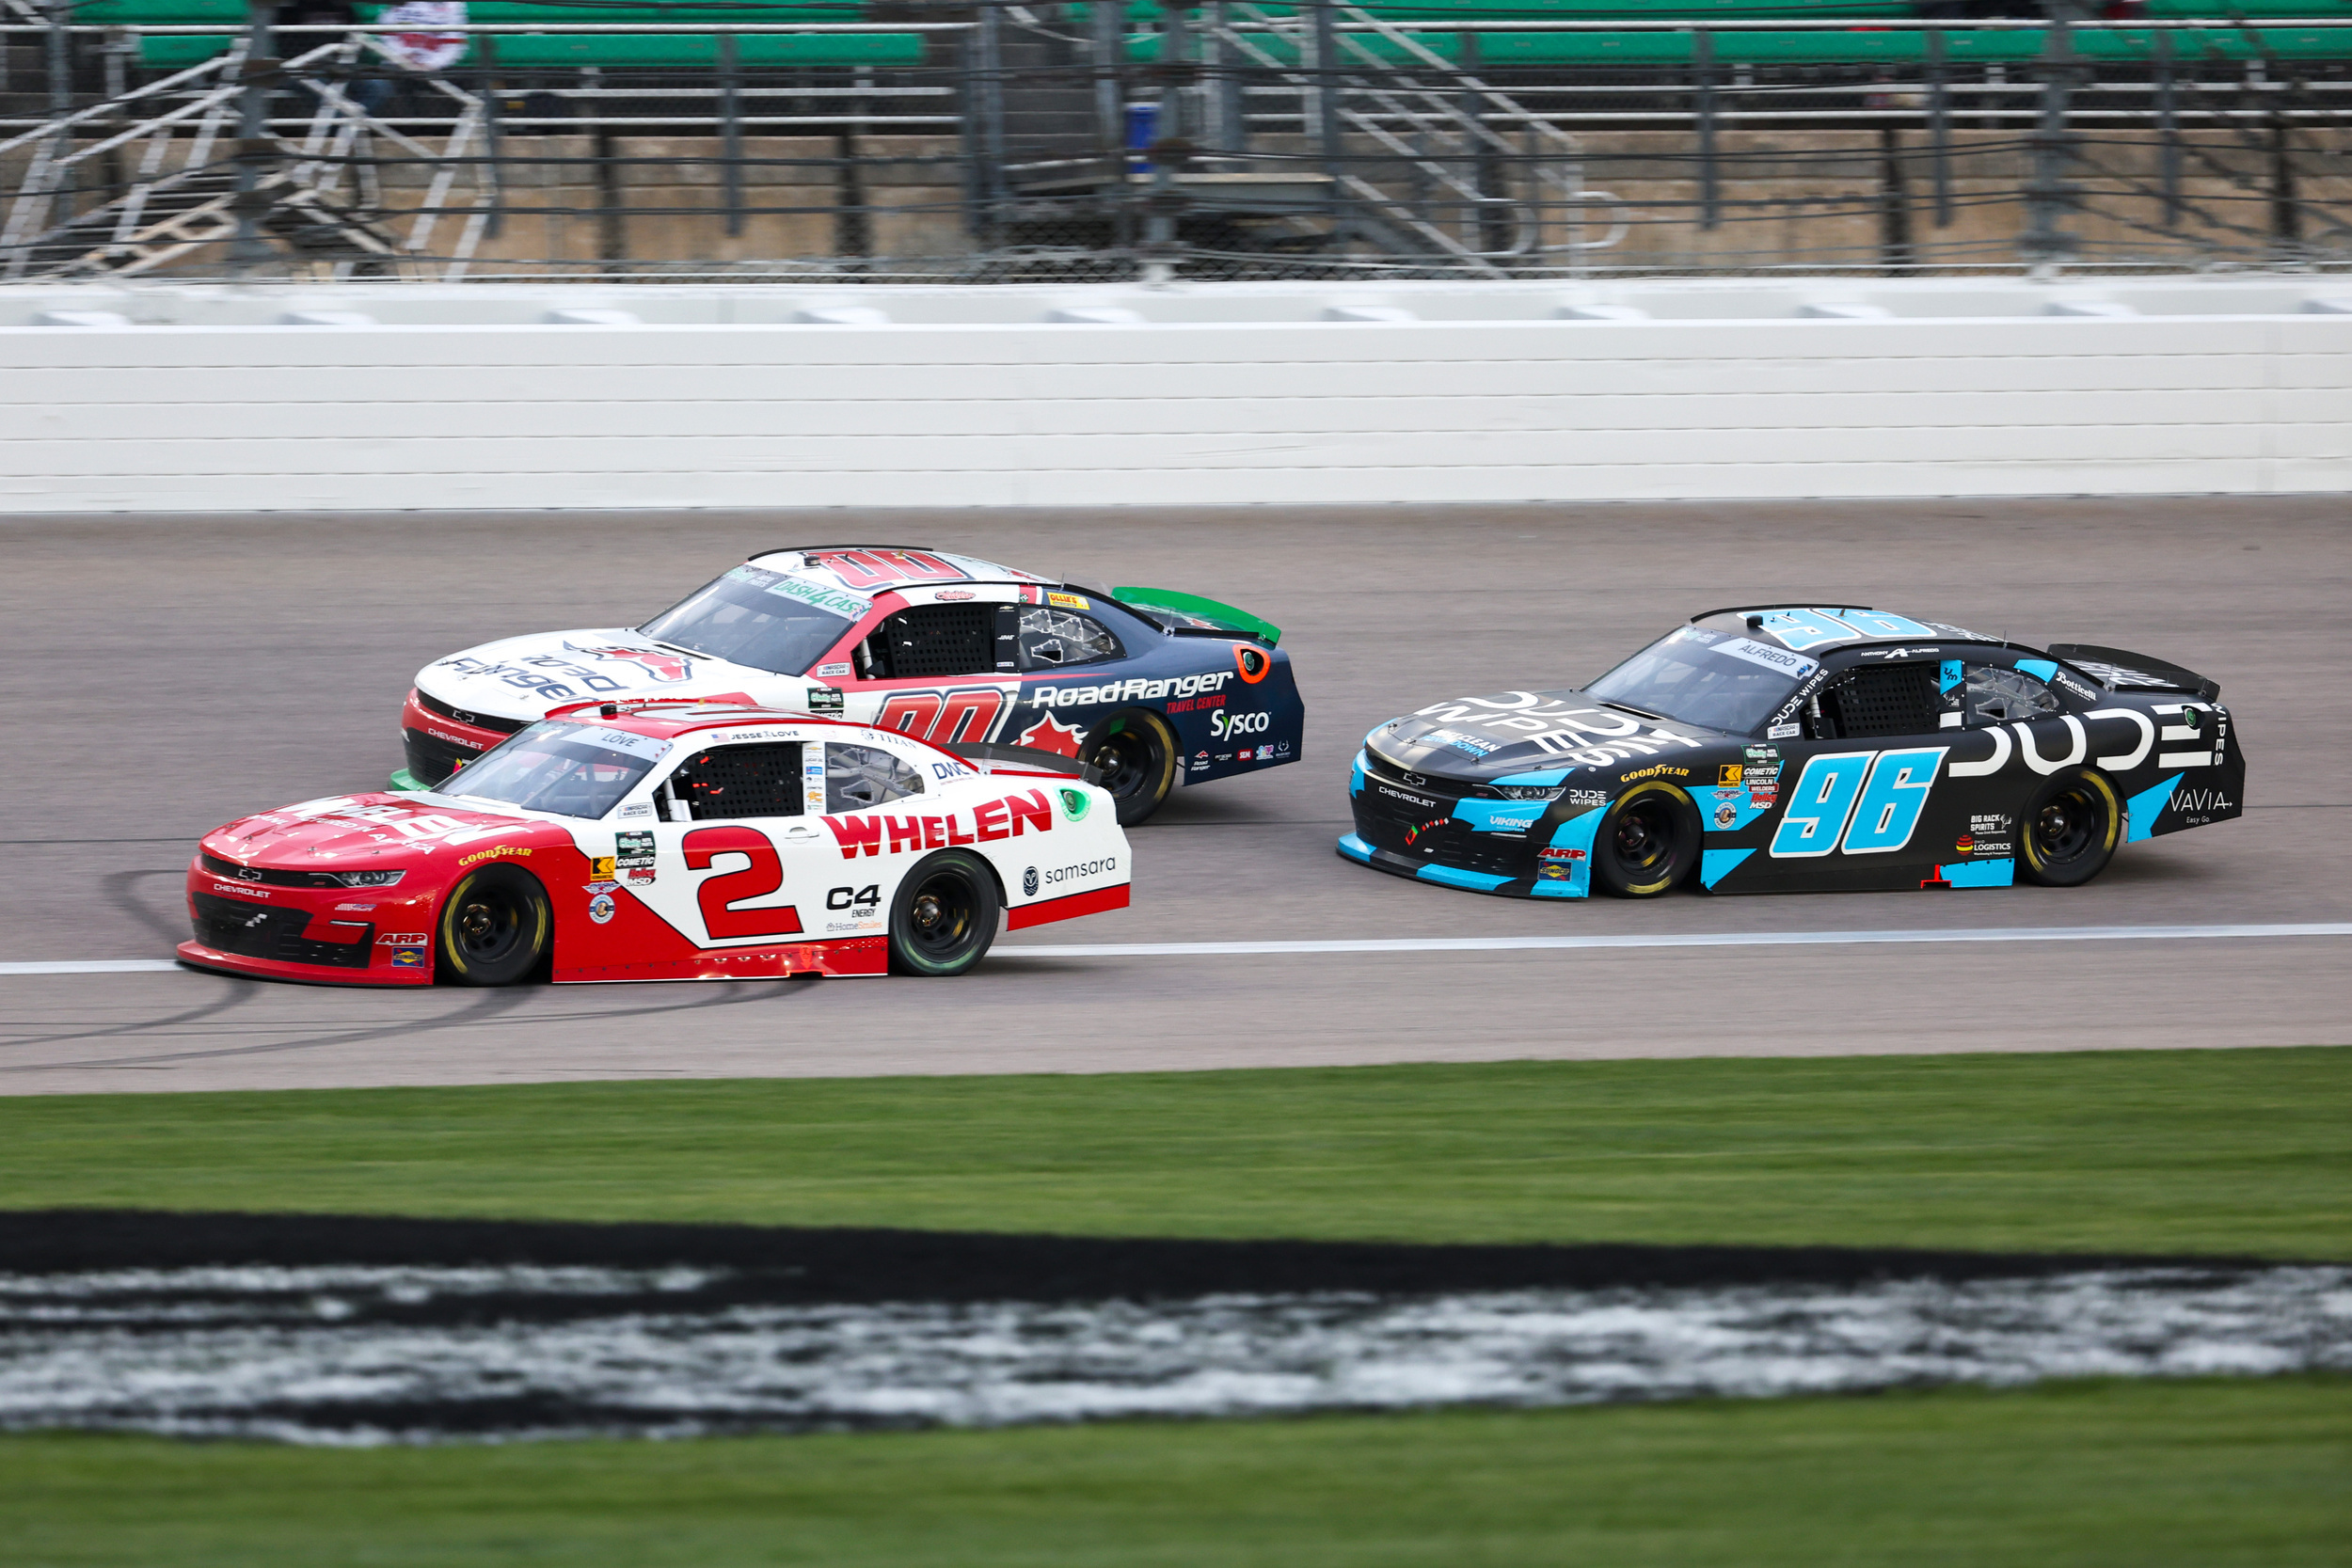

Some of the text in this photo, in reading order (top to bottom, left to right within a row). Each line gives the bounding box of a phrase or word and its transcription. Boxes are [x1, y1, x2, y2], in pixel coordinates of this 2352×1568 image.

[774, 580, 814, 597] DASH
[806, 590, 836, 606] 4
[1739, 644, 1797, 667] ALFREDO
[1799, 668, 1829, 697] WIPES
[2056, 671, 2097, 701] Botticelli
[1167, 694, 1227, 714] TRAVEL CENTER
[428, 728, 485, 750] CHEVROLET
[601, 734, 639, 747] LOVE
[731, 731, 763, 739] JESSE
[2211, 702, 2227, 767] WIPES
[877, 734, 917, 750] TITAN
[1450, 740, 1489, 757] DOWN
[1457, 735, 1502, 752] CLEAN
[1743, 766, 1778, 776] COMETIC
[1378, 786, 1437, 808] CHEVROLET
[1569, 789, 1607, 799] DUDE
[1751, 793, 1777, 803] Holley
[1570, 799, 1607, 807] WIPES
[1769, 746, 1950, 858] 96
[818, 788, 1052, 860] WHELEN
[1489, 815, 1534, 829] VIKING
[1971, 814, 2000, 823] BIG RACK
[2186, 816, 2200, 825] Easy
[1970, 823, 1994, 832] SPIRITS
[1540, 847, 1586, 860] ARP
[1974, 843, 2011, 851] LOGISTICS
[617, 856, 655, 867] COMETIC
[1045, 857, 1116, 884] samsara
[1540, 866, 1569, 875] SUNOCO
[627, 878, 652, 886] MSD
[681, 825, 804, 941] 2
[214, 883, 271, 898] CHEVROLET
[826, 884, 882, 911] C4
[851, 909, 877, 918] ENERGY
[377, 934, 427, 944] ARP
